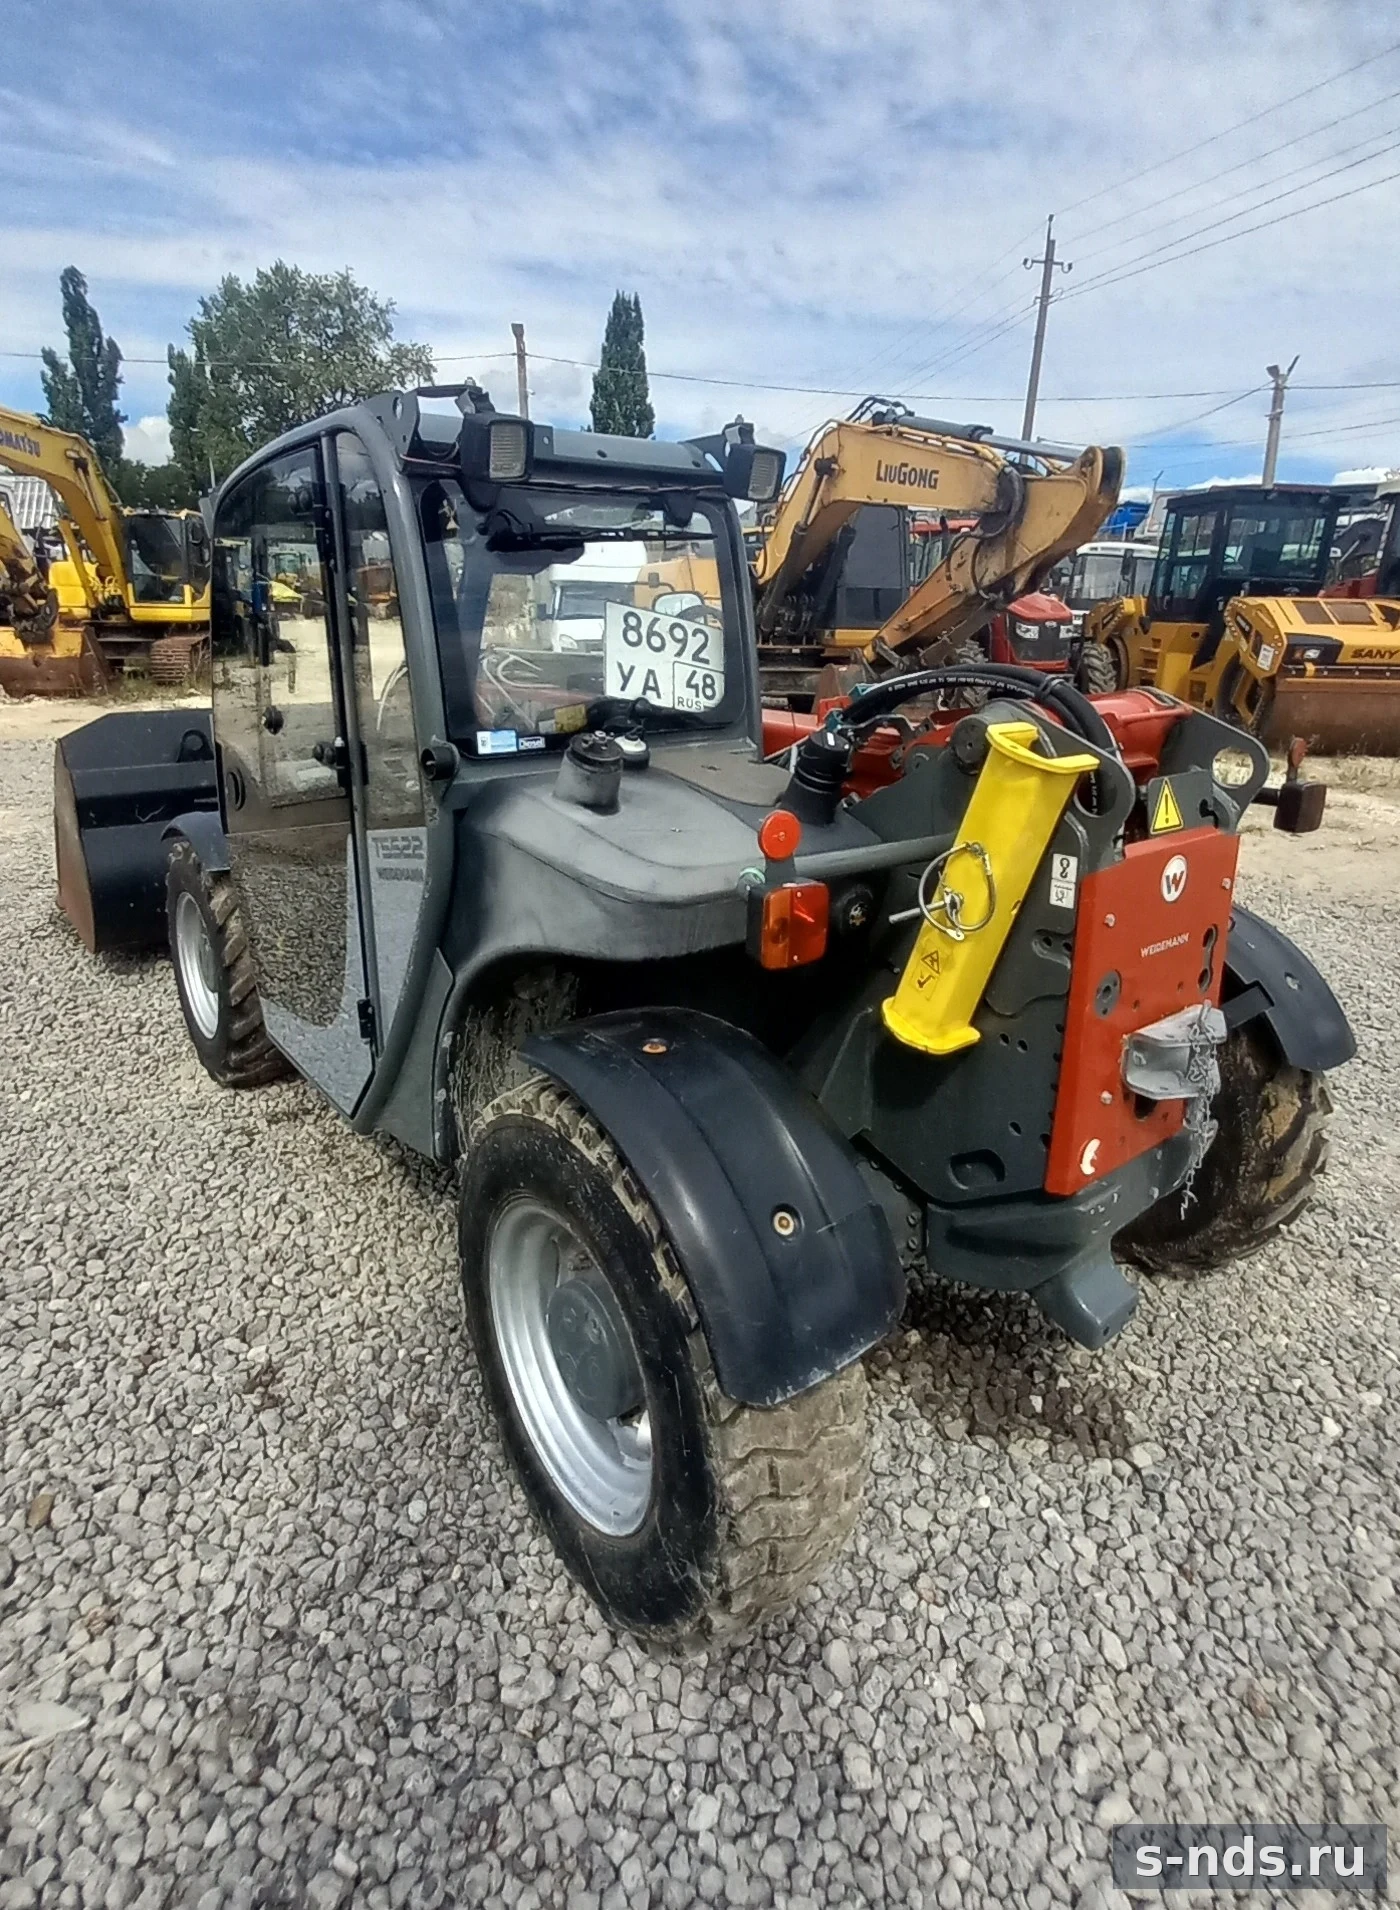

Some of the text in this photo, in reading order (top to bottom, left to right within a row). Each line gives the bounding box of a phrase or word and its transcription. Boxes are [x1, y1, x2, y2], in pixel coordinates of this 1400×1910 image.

[622, 611, 710, 665] 8692
[1350, 648, 1400, 660] SANY
[685, 669, 717, 701] 48
[676, 696, 702, 711] RUS
[1140, 932, 1190, 958] WEIDEMANN
